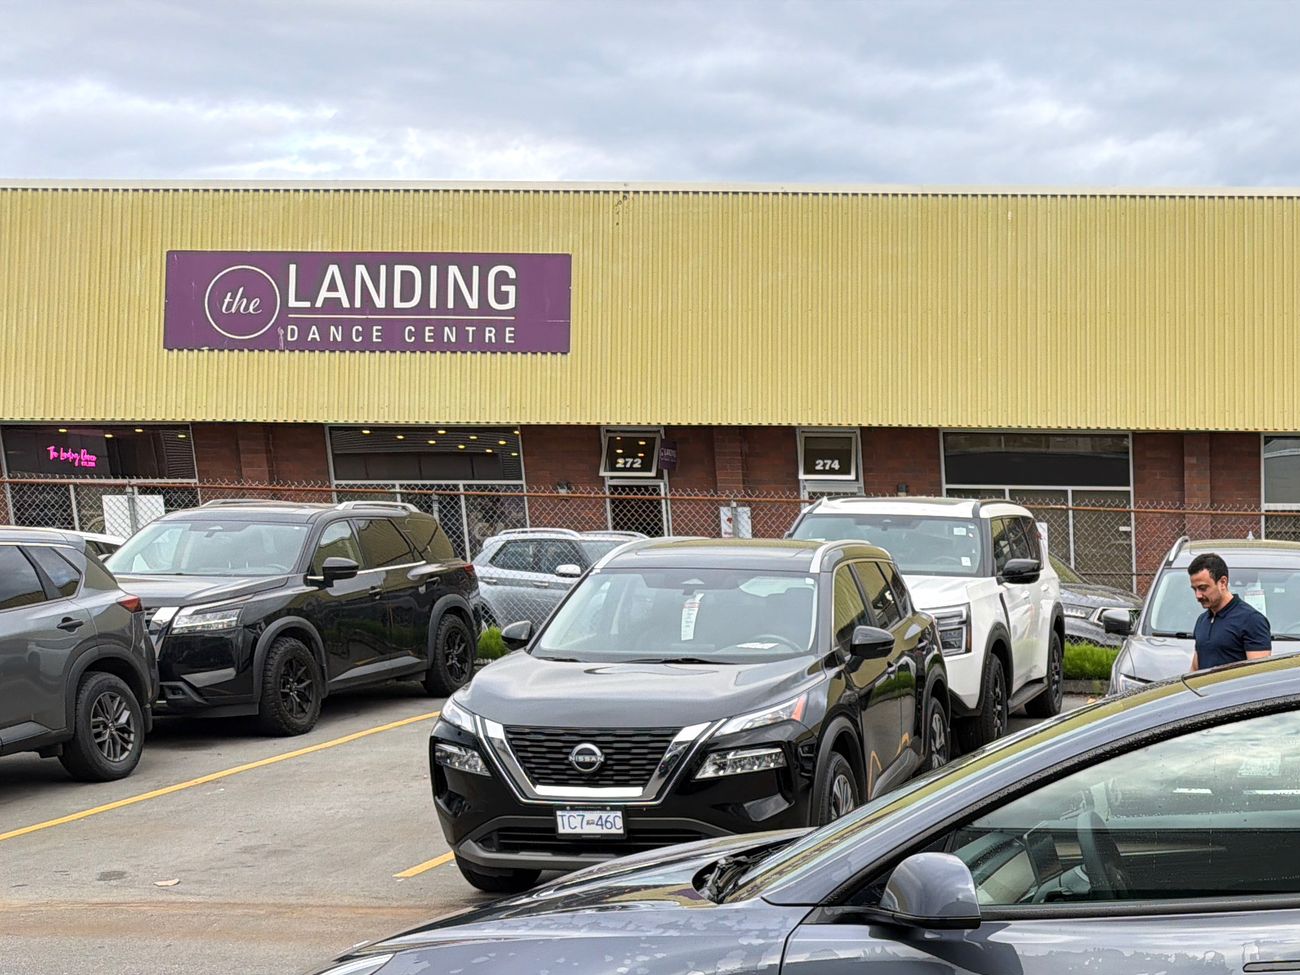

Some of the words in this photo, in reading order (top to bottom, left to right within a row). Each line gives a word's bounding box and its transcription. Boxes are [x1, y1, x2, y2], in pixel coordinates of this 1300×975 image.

[221, 286, 262, 314] the
[287, 263, 517, 311] LANDING
[287, 325, 382, 343] DANCE
[405, 326, 516, 344] CENTRE
[615, 457, 642, 468] 272
[814, 459, 841, 470] 274
[568, 754, 605, 762] NISSAN
